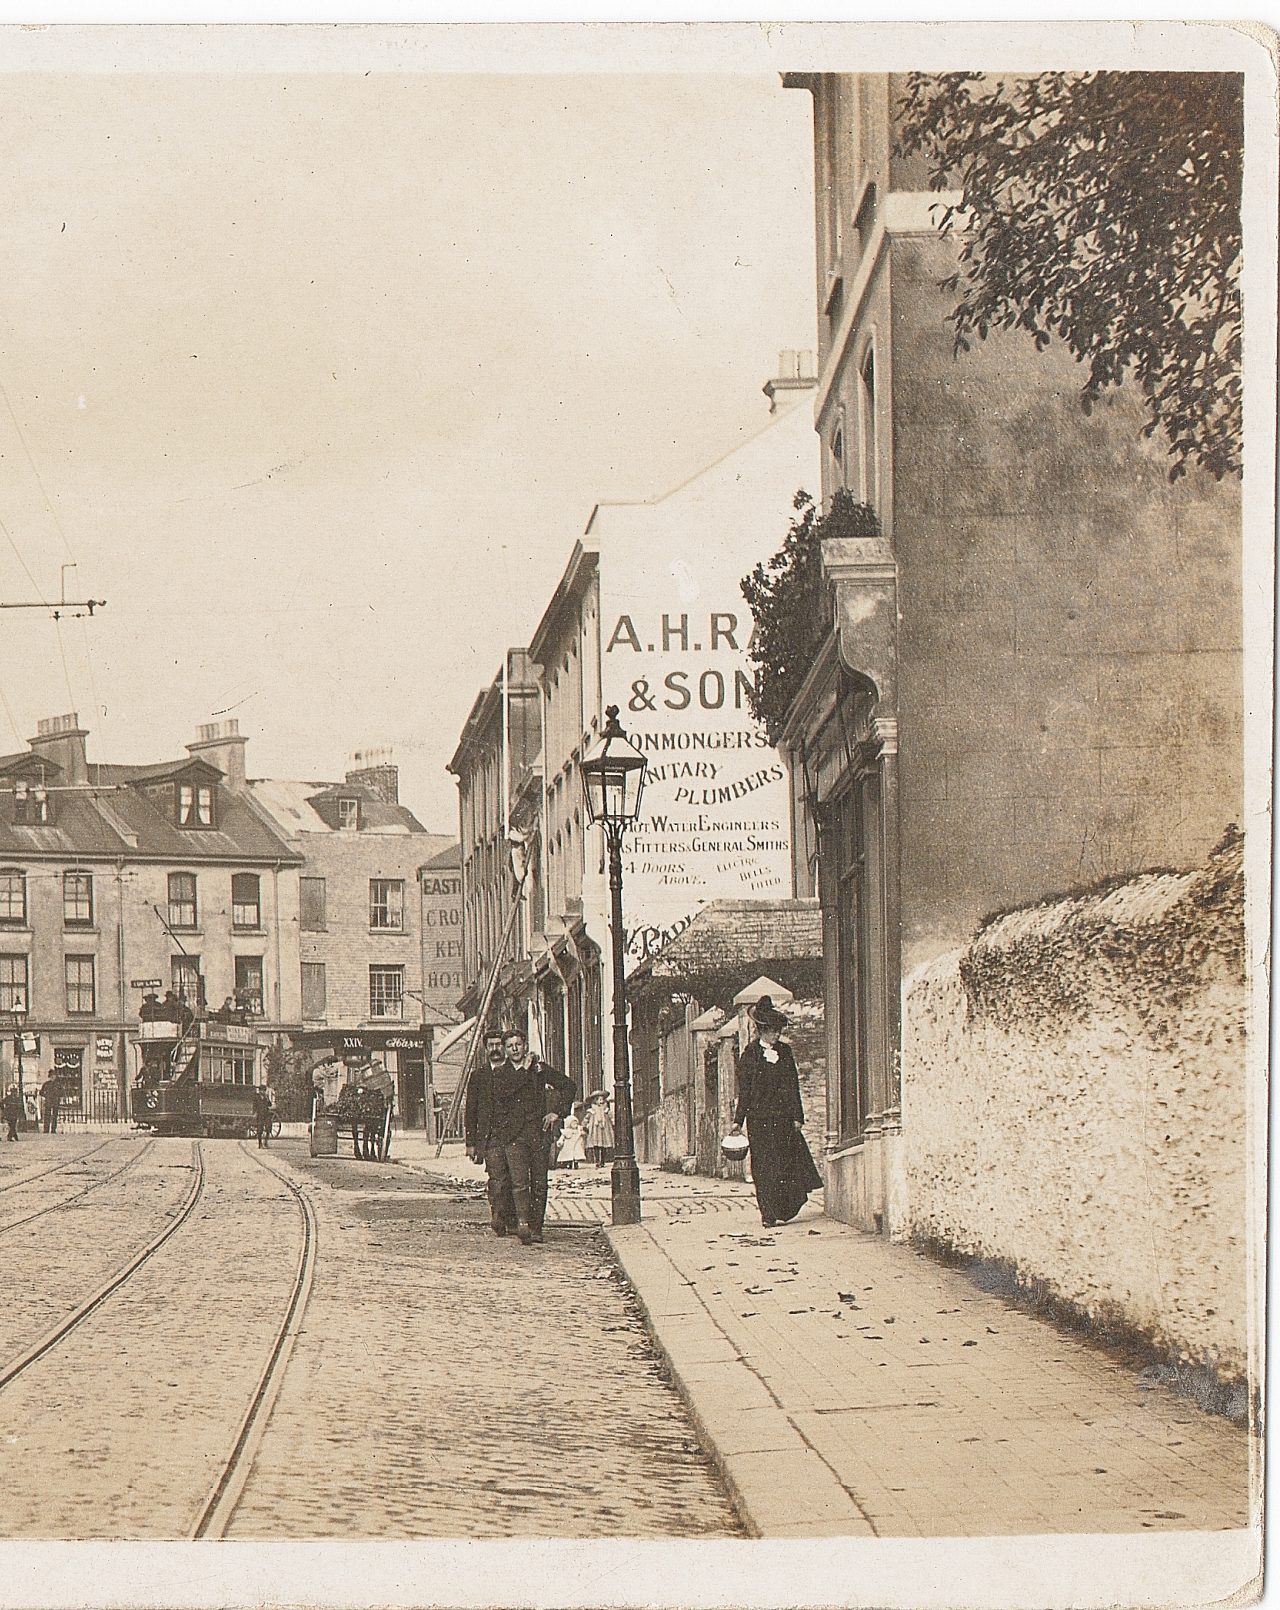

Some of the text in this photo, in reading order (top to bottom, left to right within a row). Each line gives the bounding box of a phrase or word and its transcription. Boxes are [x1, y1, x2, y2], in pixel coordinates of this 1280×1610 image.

[629, 731, 768, 751] ONMONGERS
[644, 762, 723, 788] NITARY
[674, 764, 784, 806] PLUMBERS
[651, 815, 698, 832] WATER
[698, 814, 780, 833] ENGINEERS
[692, 837, 744, 853] GENERAL
[746, 835, 789, 851] SMITHS
[642, 862, 686, 874] DOORS
